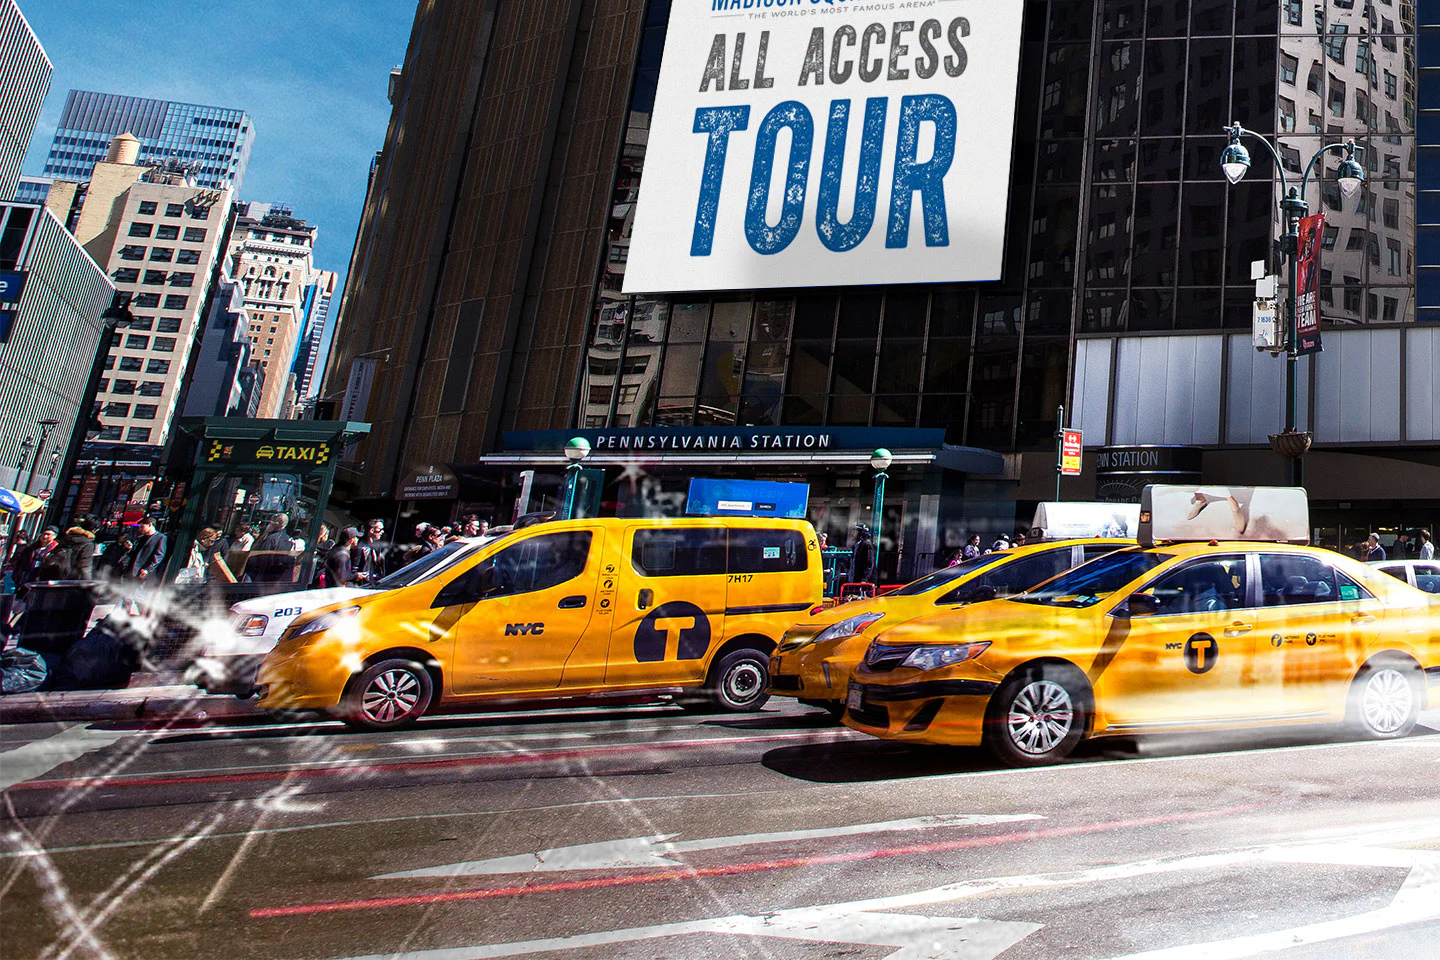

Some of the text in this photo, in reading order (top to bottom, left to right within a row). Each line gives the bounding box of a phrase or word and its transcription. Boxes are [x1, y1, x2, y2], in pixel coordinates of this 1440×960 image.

[748, 12, 767, 20] THE
[771, 9, 816, 19] WORLD'S
[820, 6, 849, 15] MOST
[853, 3, 896, 13] FAMOUS
[698, 16, 971, 92] ALL ACCESS
[690, 93, 958, 257] TOUR
[1297, 310, 1317, 328] TEAM
[596, 434, 830, 449] PENNSYLVANIA STATION
[276, 446, 316, 460] TAXI
[1111, 451, 1158, 467] STATION
[416, 474, 443, 483] PENN PLAZA
[728, 575, 754, 583] 7H17
[273, 606, 303, 618] 203
[504, 622, 545, 637] NYC
[654, 616, 696, 661] T
[1165, 642, 1182, 650] NYC
